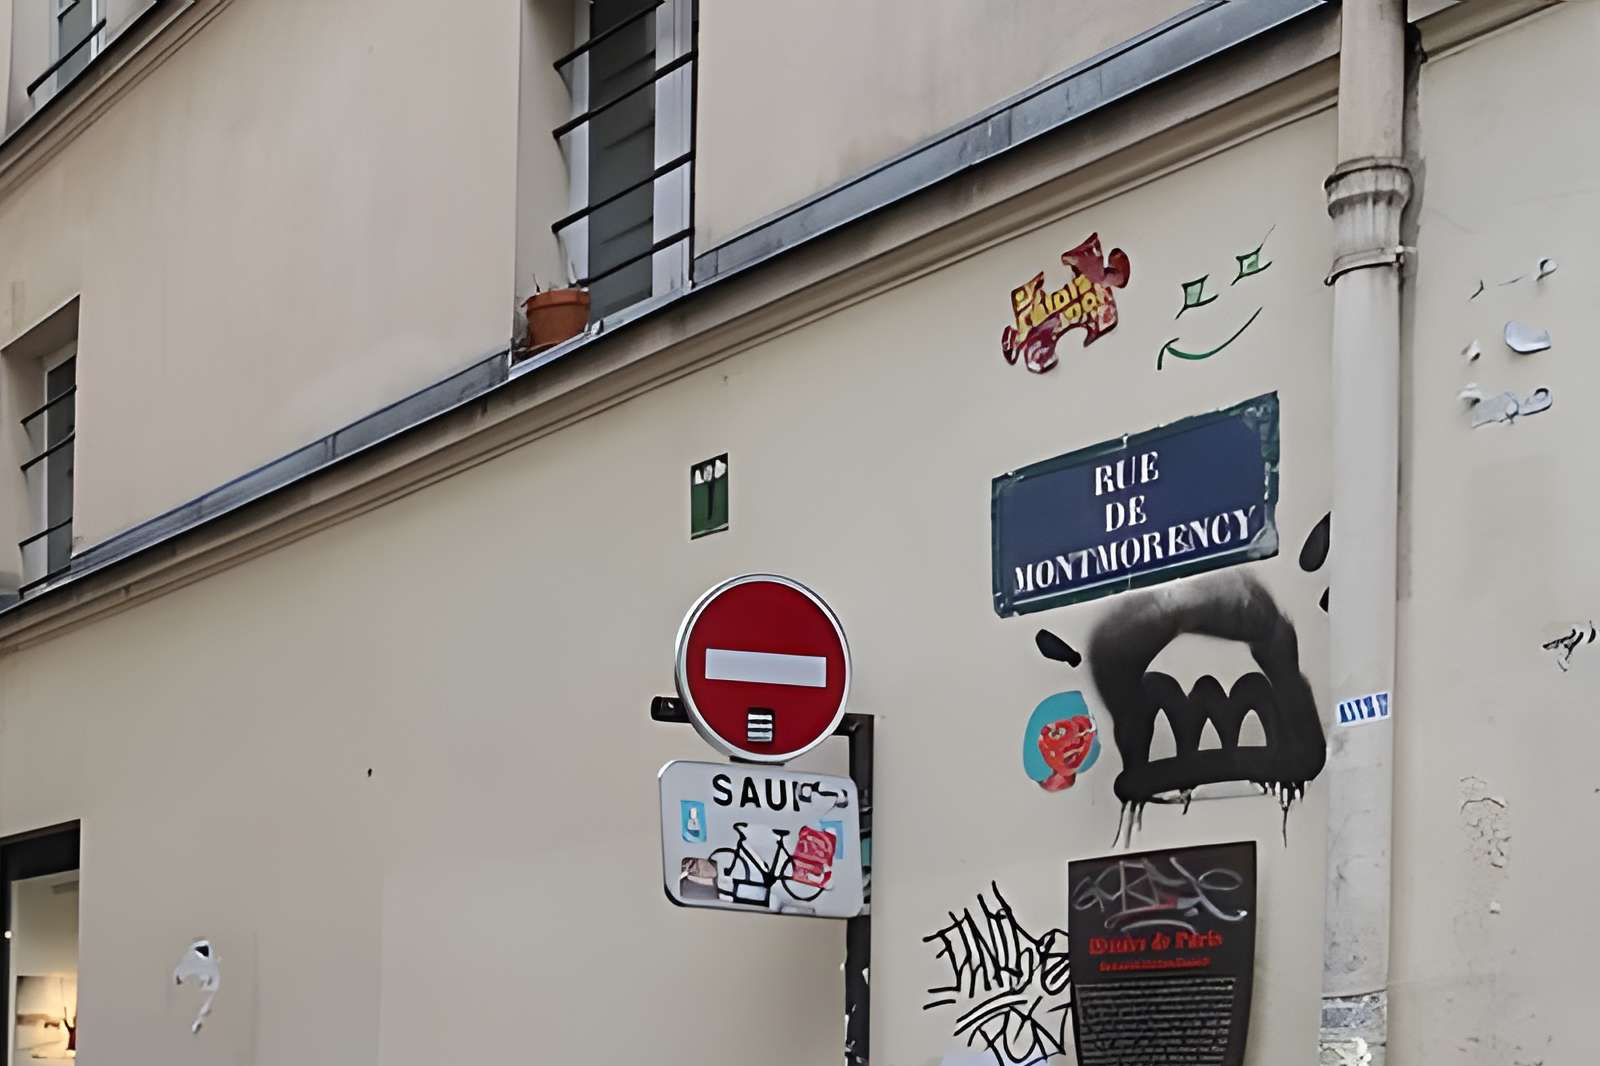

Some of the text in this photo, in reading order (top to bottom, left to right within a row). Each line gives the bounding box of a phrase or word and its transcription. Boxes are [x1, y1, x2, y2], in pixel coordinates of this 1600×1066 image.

[1094, 451, 1159, 496] RUE
[1105, 496, 1147, 532] DE
[1014, 505, 1257, 594] MONTMORENCY
